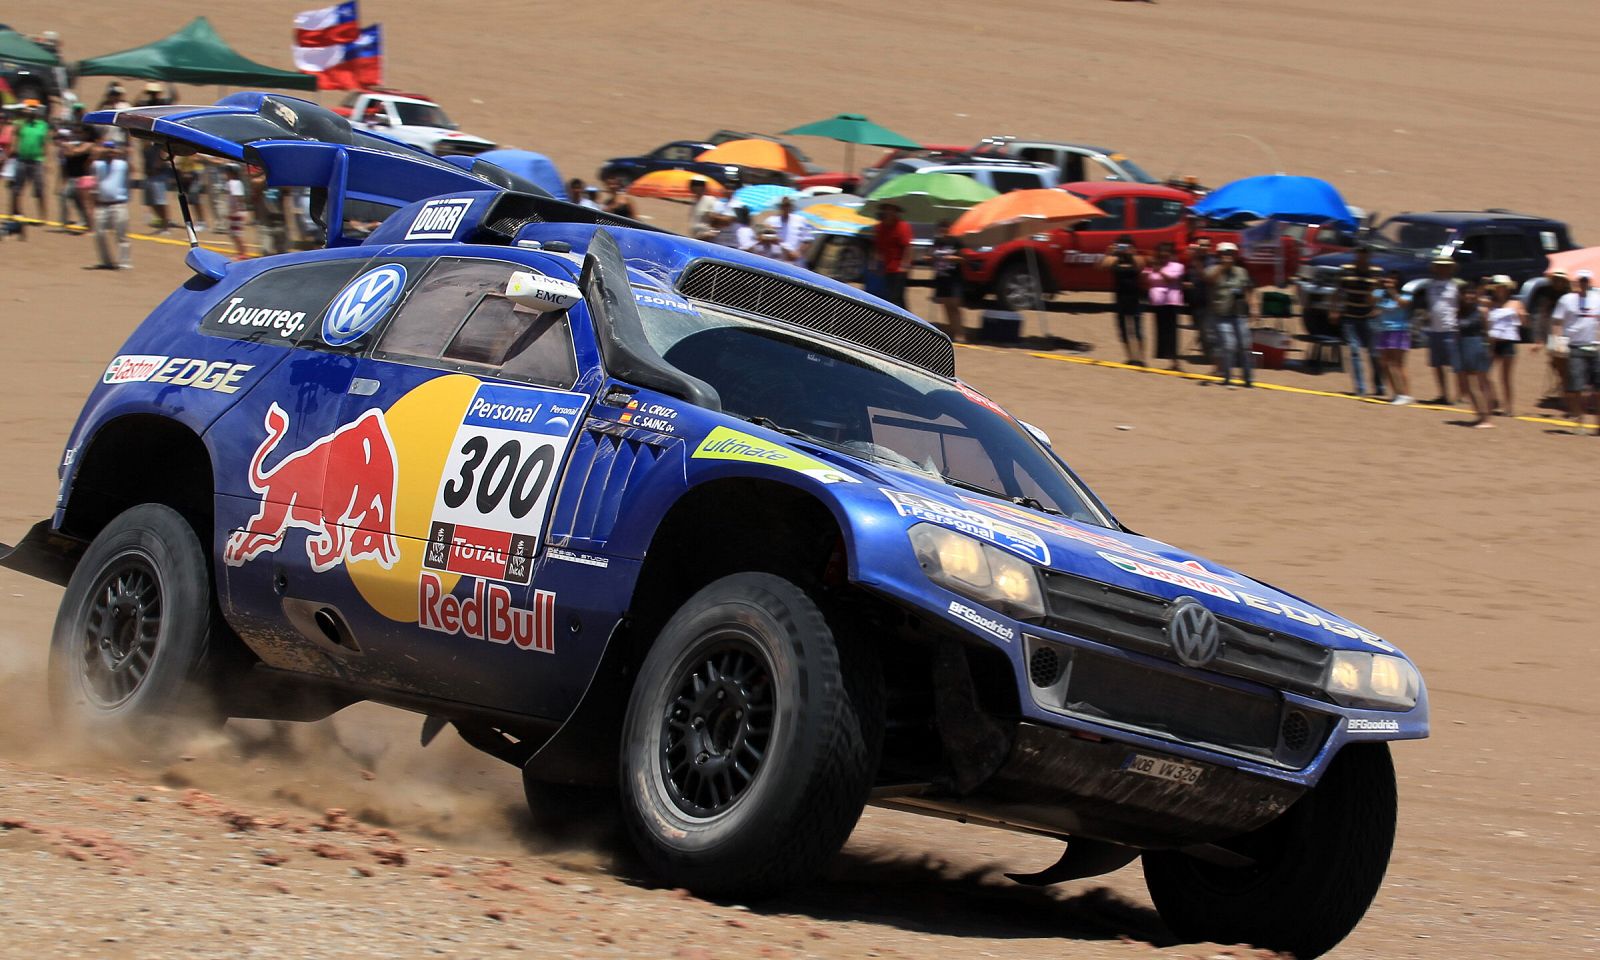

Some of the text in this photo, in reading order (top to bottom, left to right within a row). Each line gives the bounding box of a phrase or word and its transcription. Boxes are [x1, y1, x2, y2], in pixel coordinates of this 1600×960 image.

[412, 199, 463, 232] DÜRR
[634, 294, 693, 311] rsonal
[113, 357, 256, 394] Castrol EDGE
[468, 397, 579, 424] Personal Personal
[641, 416, 668, 431] SAINZ
[649, 404, 673, 418] CRUZ
[702, 438, 789, 461] ultimate
[443, 435, 555, 519] 300
[911, 504, 996, 540] Personal
[453, 537, 506, 565] TOTAL
[949, 601, 1014, 640] BFGoodrich
[1134, 562, 1395, 653] Castrol EDGE
[1347, 719, 1399, 730] BFGoodrich
